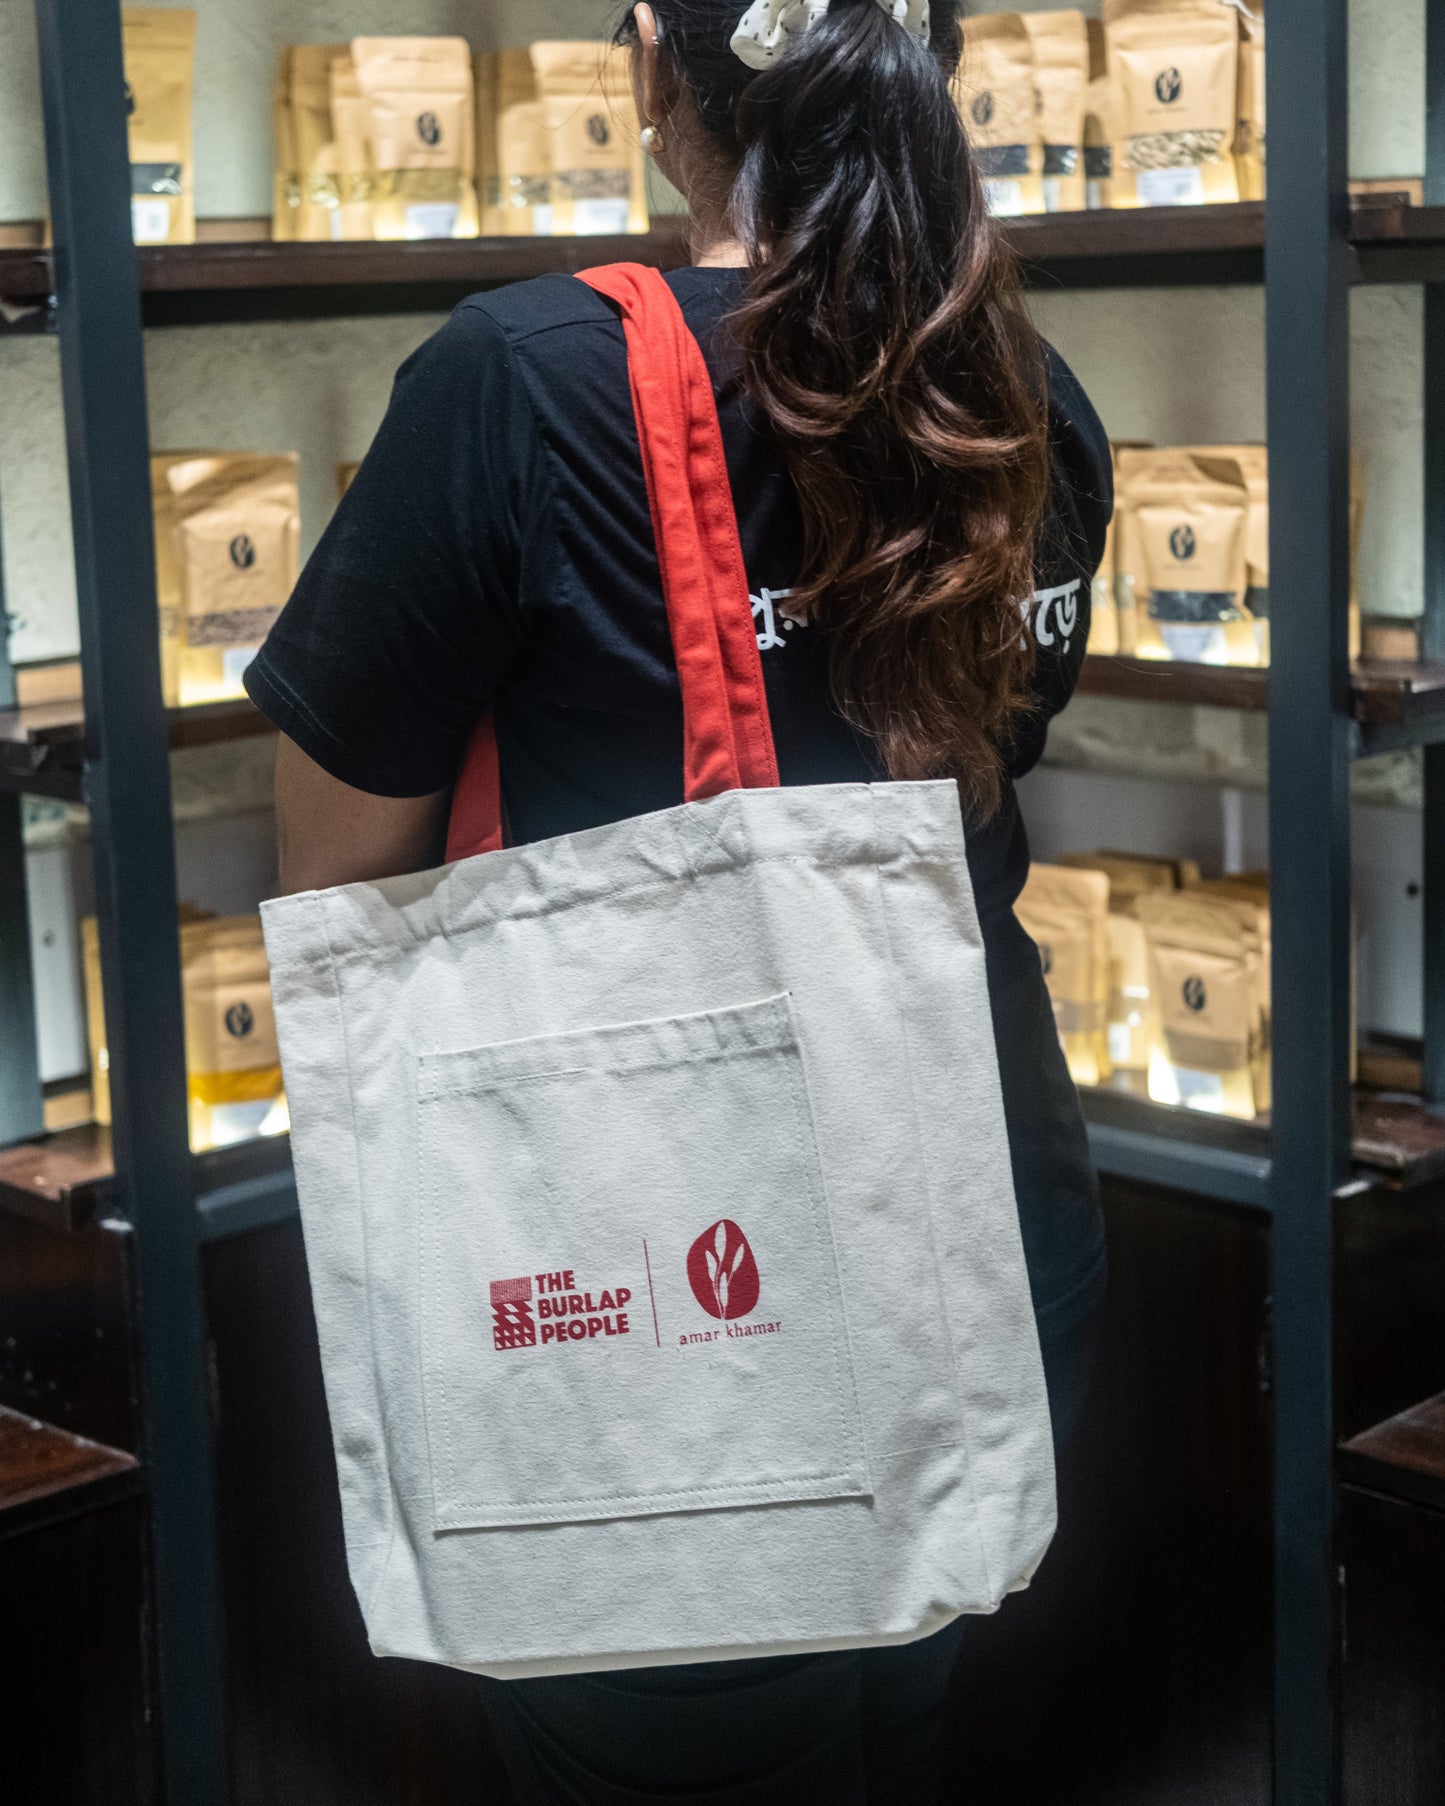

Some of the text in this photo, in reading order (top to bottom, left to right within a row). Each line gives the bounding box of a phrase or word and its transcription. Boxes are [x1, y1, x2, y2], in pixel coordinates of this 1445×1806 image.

[535, 1270, 576, 1294] THE
[537, 1288, 632, 1319] BURLAP
[540, 1313, 630, 1344] PEOPLE
[679, 1320, 783, 1346] amar khamar
